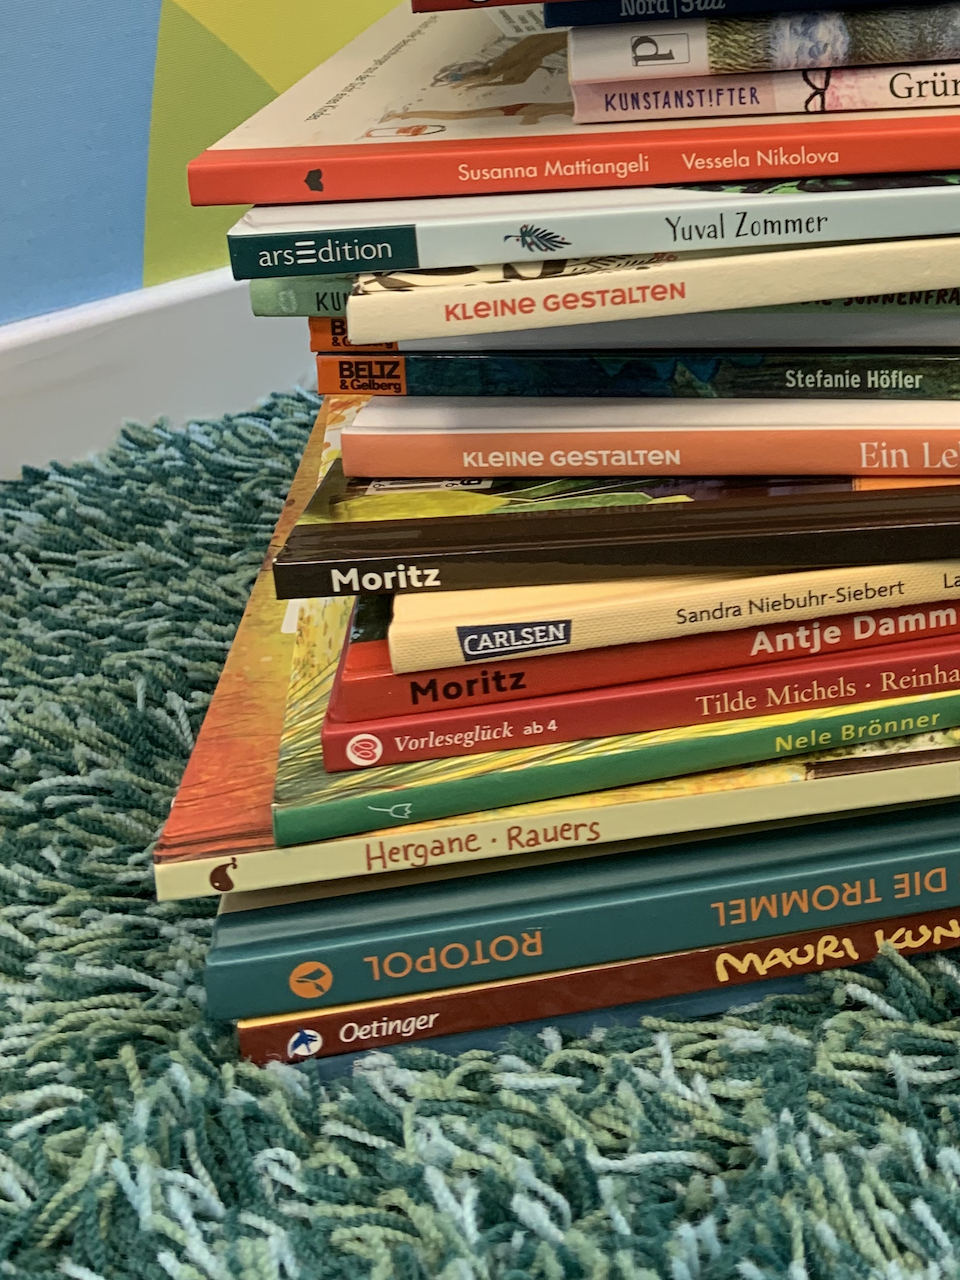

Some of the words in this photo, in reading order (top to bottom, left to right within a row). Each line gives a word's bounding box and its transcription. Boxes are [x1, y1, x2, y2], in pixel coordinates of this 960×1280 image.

[457, 162, 538, 182] Susanna
[544, 155, 649, 180] Mattiangeli
[681, 150, 750, 170] Vessela
[757, 147, 839, 168] Nikolova
[665, 216, 724, 243] Yuval
[736, 212, 828, 240] Zommer
[785, 370, 861, 389] Stefanie
[866, 369, 924, 389] Höfler
[860, 442, 910, 469] Ein
[331, 566, 440, 593] Moritz
[676, 602, 743, 625] Sandra
[748, 579, 905, 614] Niebuhr-Siebert
[464, 623, 565, 656] CARLSEN
[696, 691, 758, 716] Tilde
[765, 678, 857, 709] Michels
[395, 722, 514, 753] Vorleseglück
[523, 723, 543, 735] ab
[547, 720, 558, 733] 4
[774, 730, 832, 752] Nele
[840, 710, 941, 742] Brönner
[365, 831, 481, 871] Hergane
[507, 822, 601, 851] Rauers
[364, 931, 542, 981] ROTOPOL
[339, 1011, 439, 1044] Oetinger
